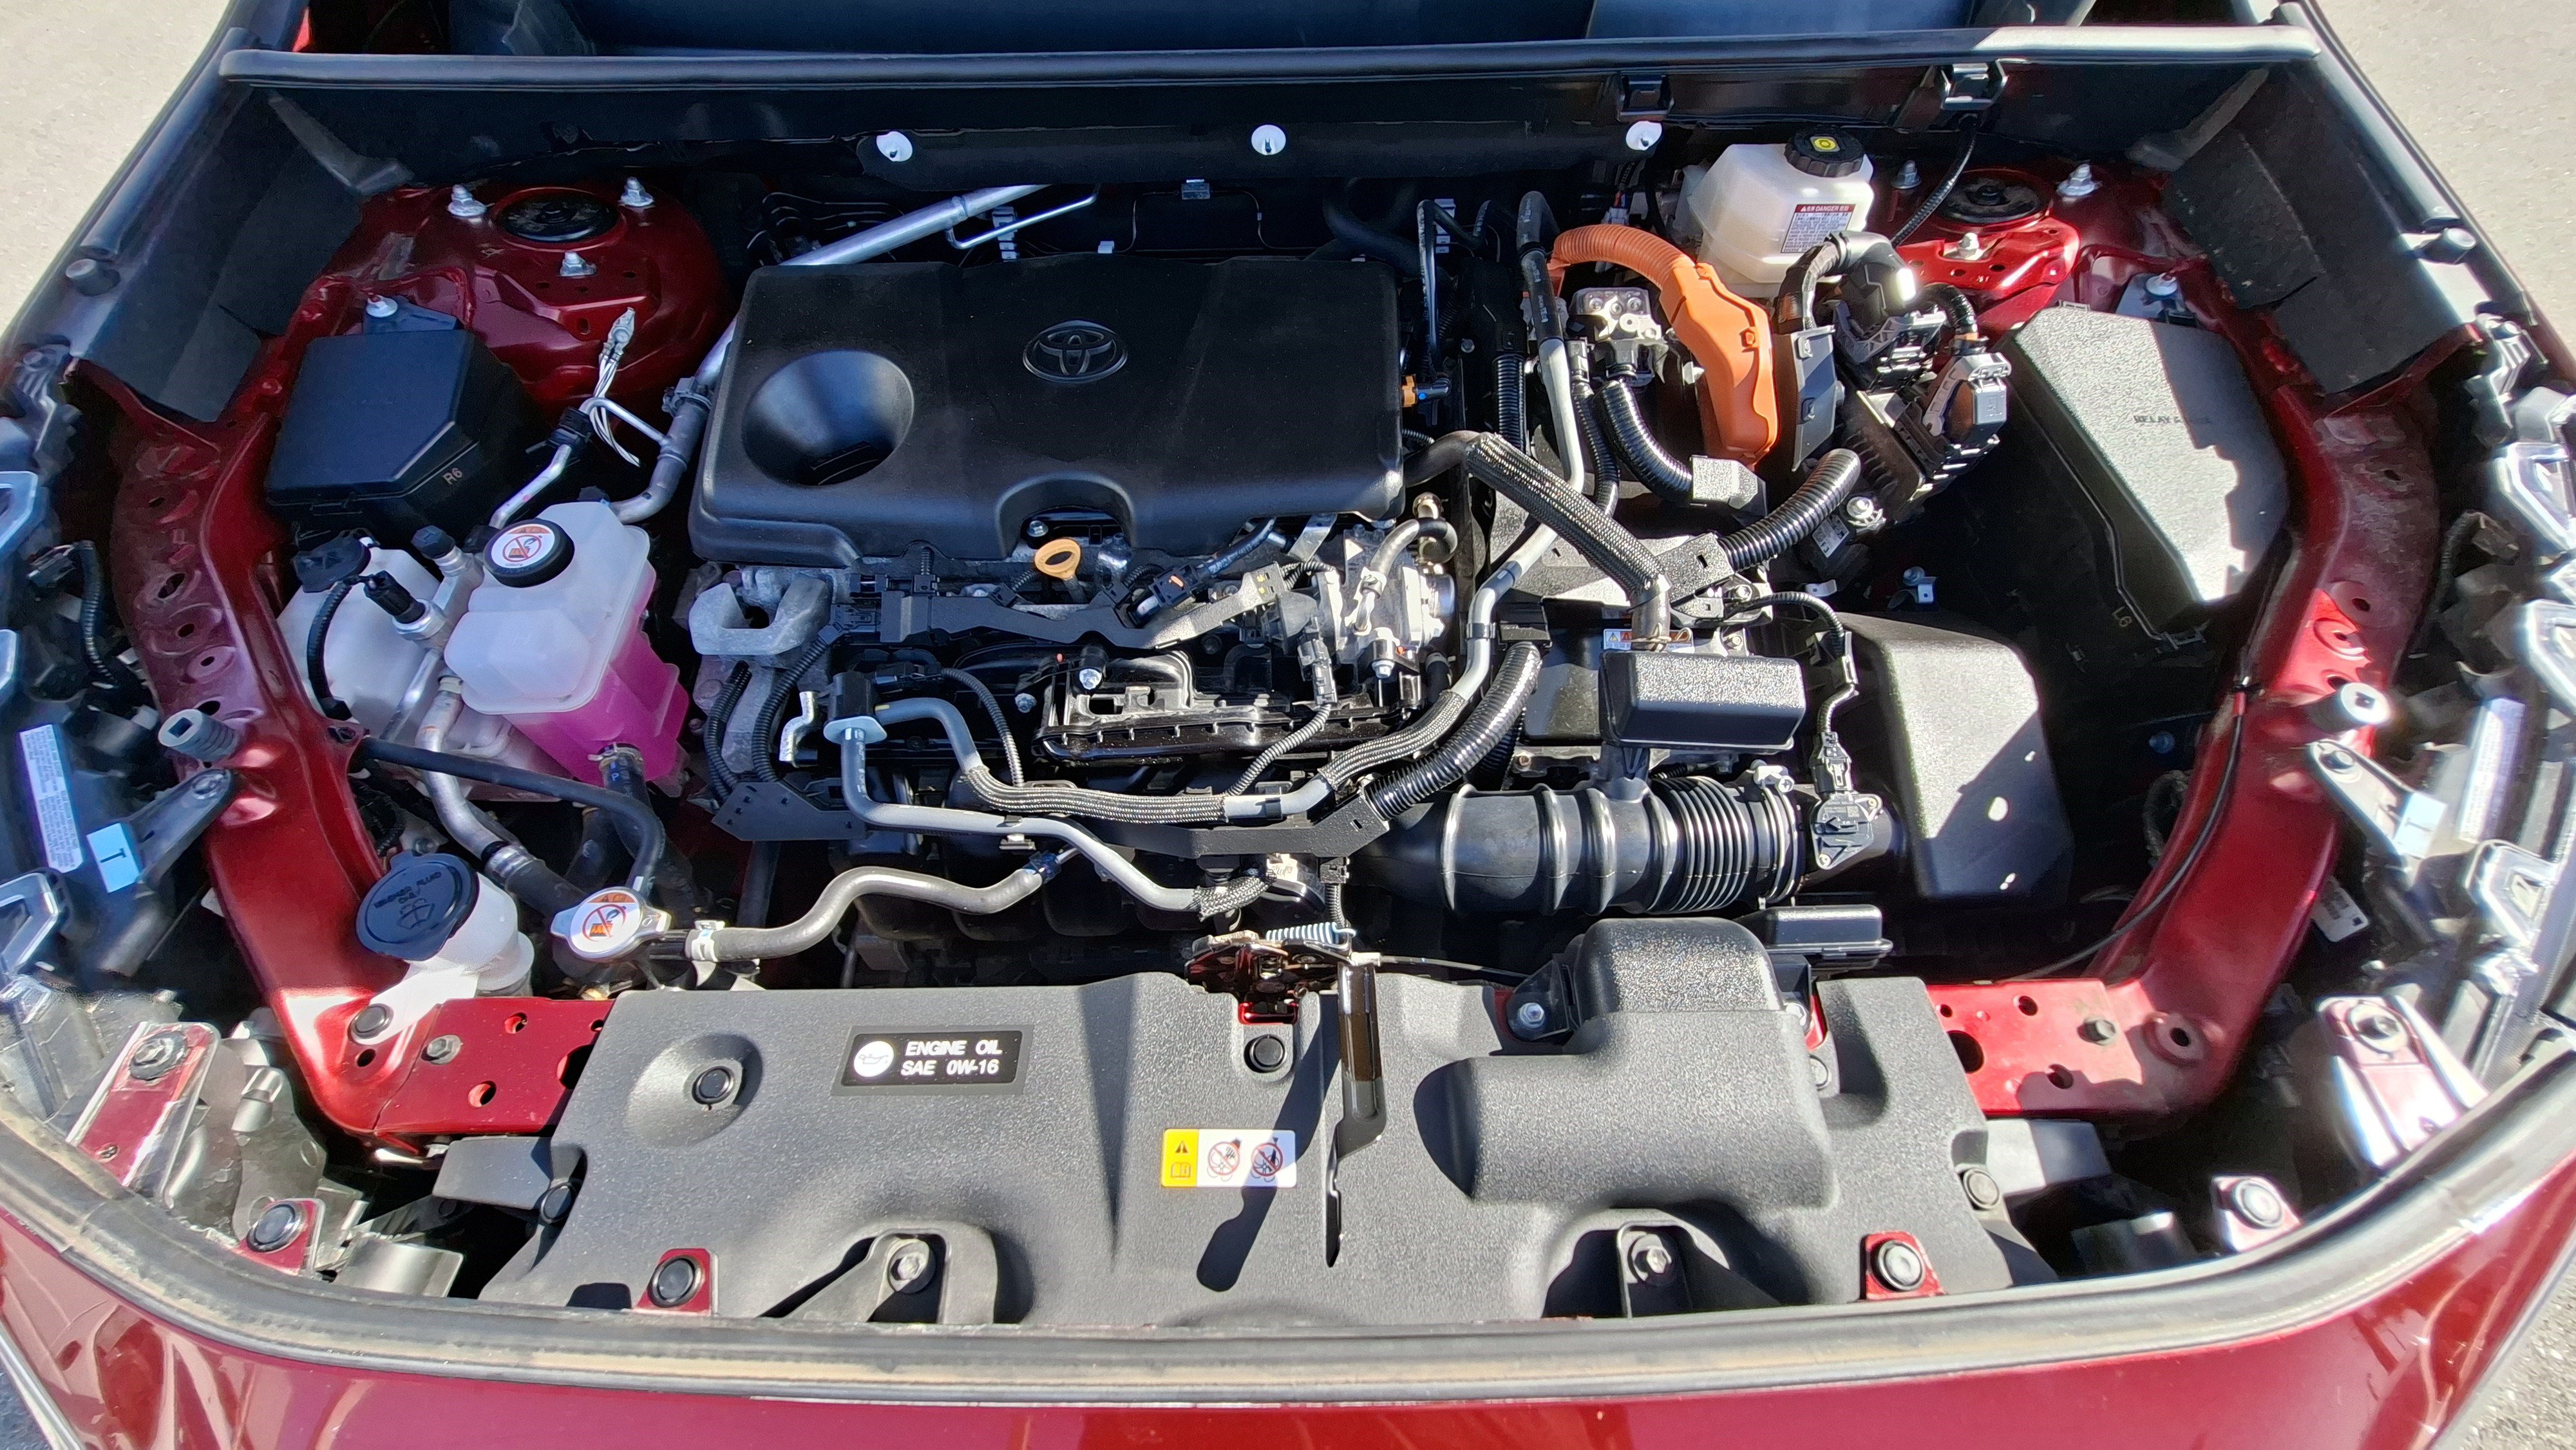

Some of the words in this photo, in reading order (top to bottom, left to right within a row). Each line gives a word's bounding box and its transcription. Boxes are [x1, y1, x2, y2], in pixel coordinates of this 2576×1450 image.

[442, 467, 463, 485] R6
[611, 773, 619, 782] P
[905, 1040, 967, 1056] ENGINE
[975, 1039, 1003, 1055] OIL
[900, 1060, 937, 1076] SAE
[946, 1059, 999, 1075] 0W-16
